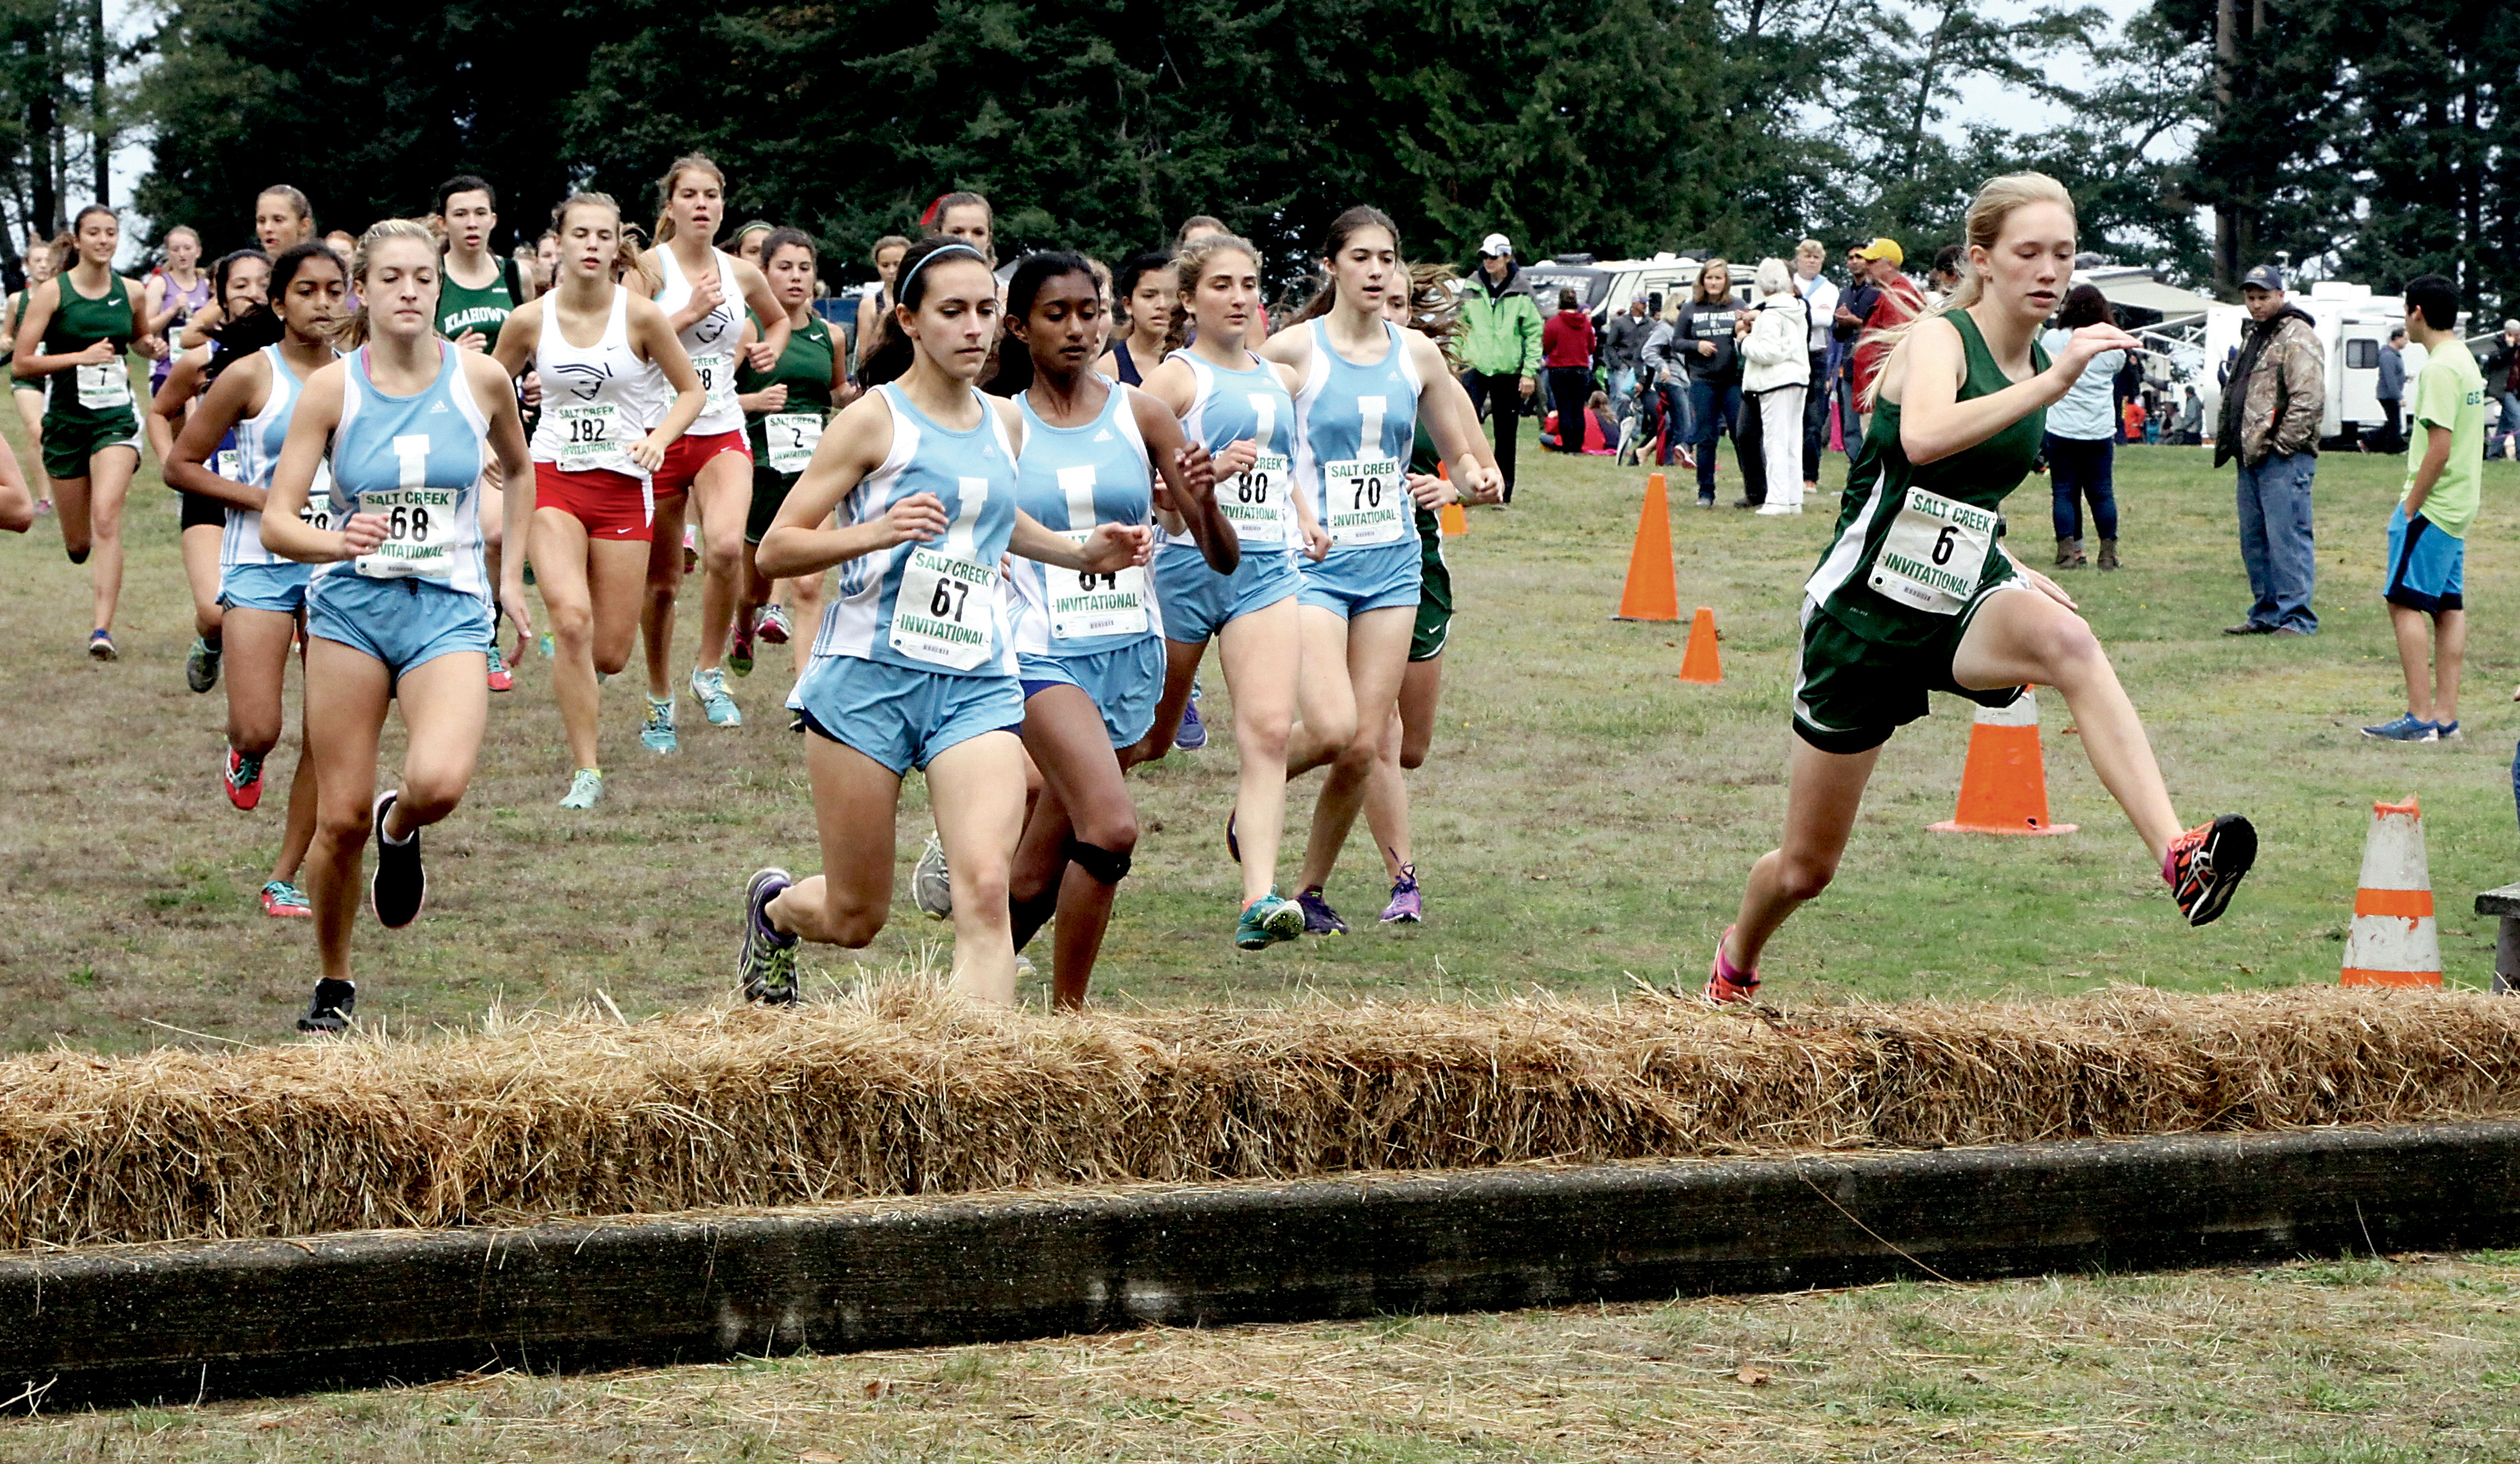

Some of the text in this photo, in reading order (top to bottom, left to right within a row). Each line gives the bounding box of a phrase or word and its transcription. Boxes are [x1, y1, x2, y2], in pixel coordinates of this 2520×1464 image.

[99, 367, 107, 386] 7
[559, 406, 615, 419] SALT CREEK
[570, 418, 606, 443] 182
[792, 428, 803, 447] 2
[561, 442, 618, 455] INVITATIONAL
[774, 449, 815, 459] INVITATION
[1331, 461, 1395, 477] SALT CREEK
[366, 491, 449, 506] SALT CREEK
[1239, 472, 1268, 504] 80
[1351, 477, 1381, 510] 70
[1220, 504, 1278, 521] NVITATIONAL
[1334, 509, 1396, 527] INVITATIONAL
[1913, 494, 1991, 533] SALT CREEK
[390, 506, 429, 542] 68
[375, 543, 443, 559] VITATIONAL
[1932, 526, 1960, 565] 6
[915, 552, 990, 587] SALT CREEK
[1885, 553, 1969, 597] INVITATIONAL
[930, 578, 969, 623] 67
[1056, 592, 1138, 613] INVITATIONAL
[900, 614, 984, 647] INVITATIONAL
